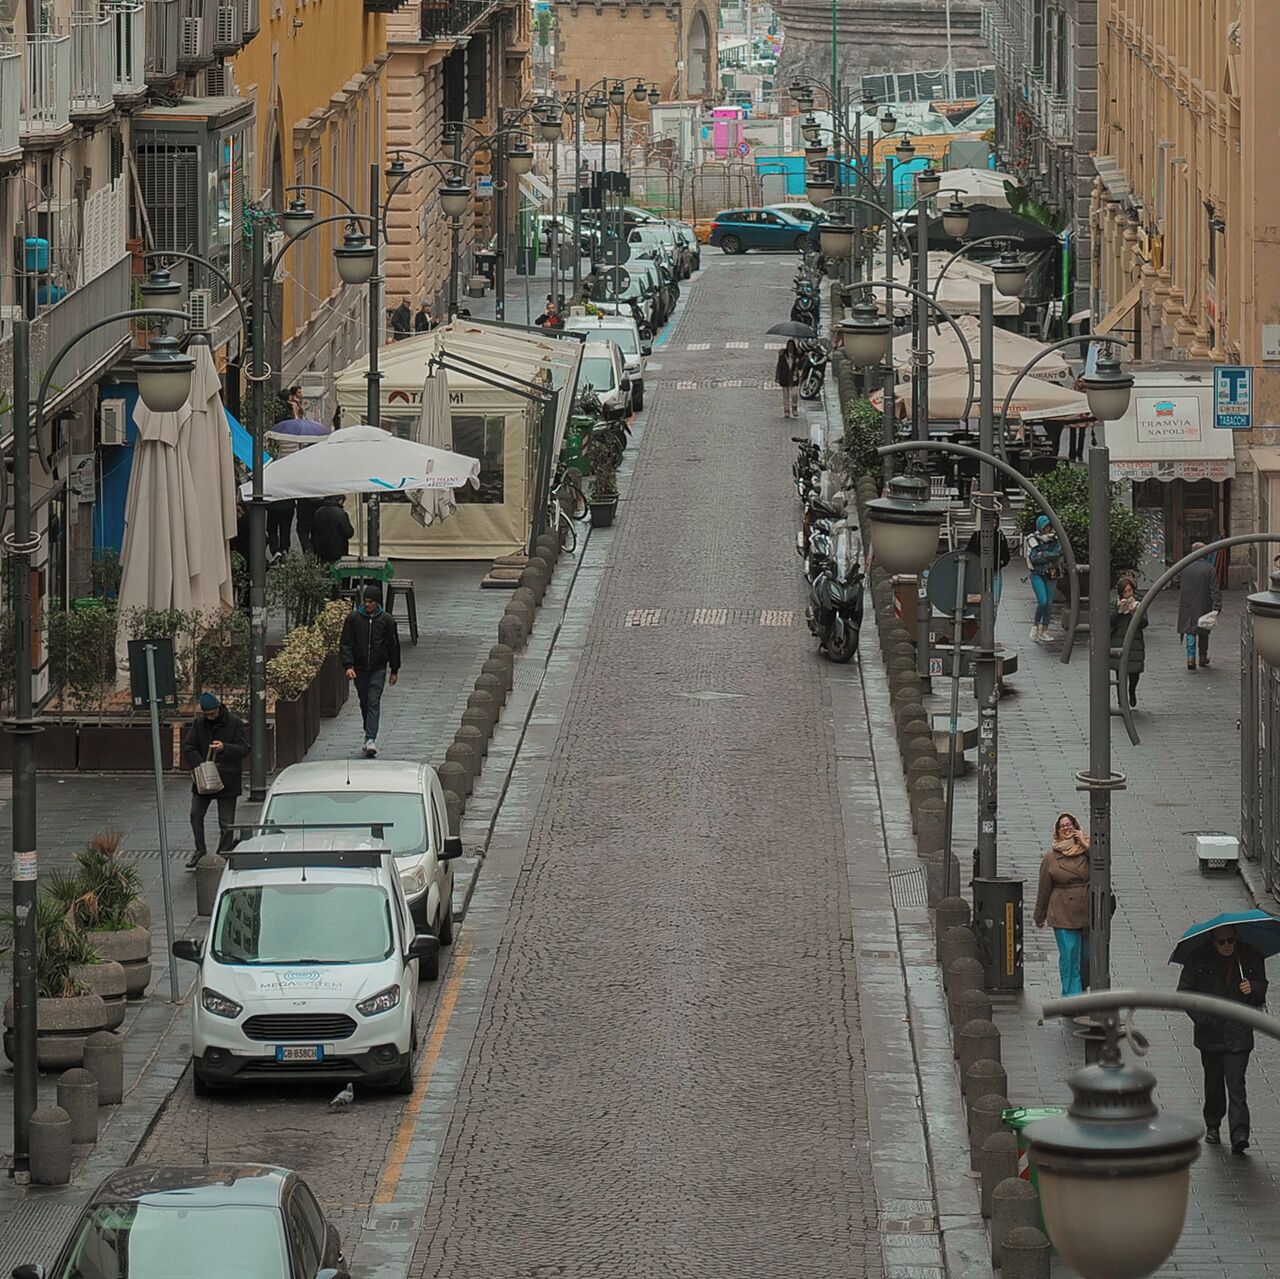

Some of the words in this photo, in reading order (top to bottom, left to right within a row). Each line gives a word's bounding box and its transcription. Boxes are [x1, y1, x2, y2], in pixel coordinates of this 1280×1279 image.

[1221, 371, 1246, 401] T
[1140, 420, 1191, 428] TRAMVIA
[1219, 416, 1247, 425] TABACCHI
[260, 980, 343, 989] MEGASYSTEM
